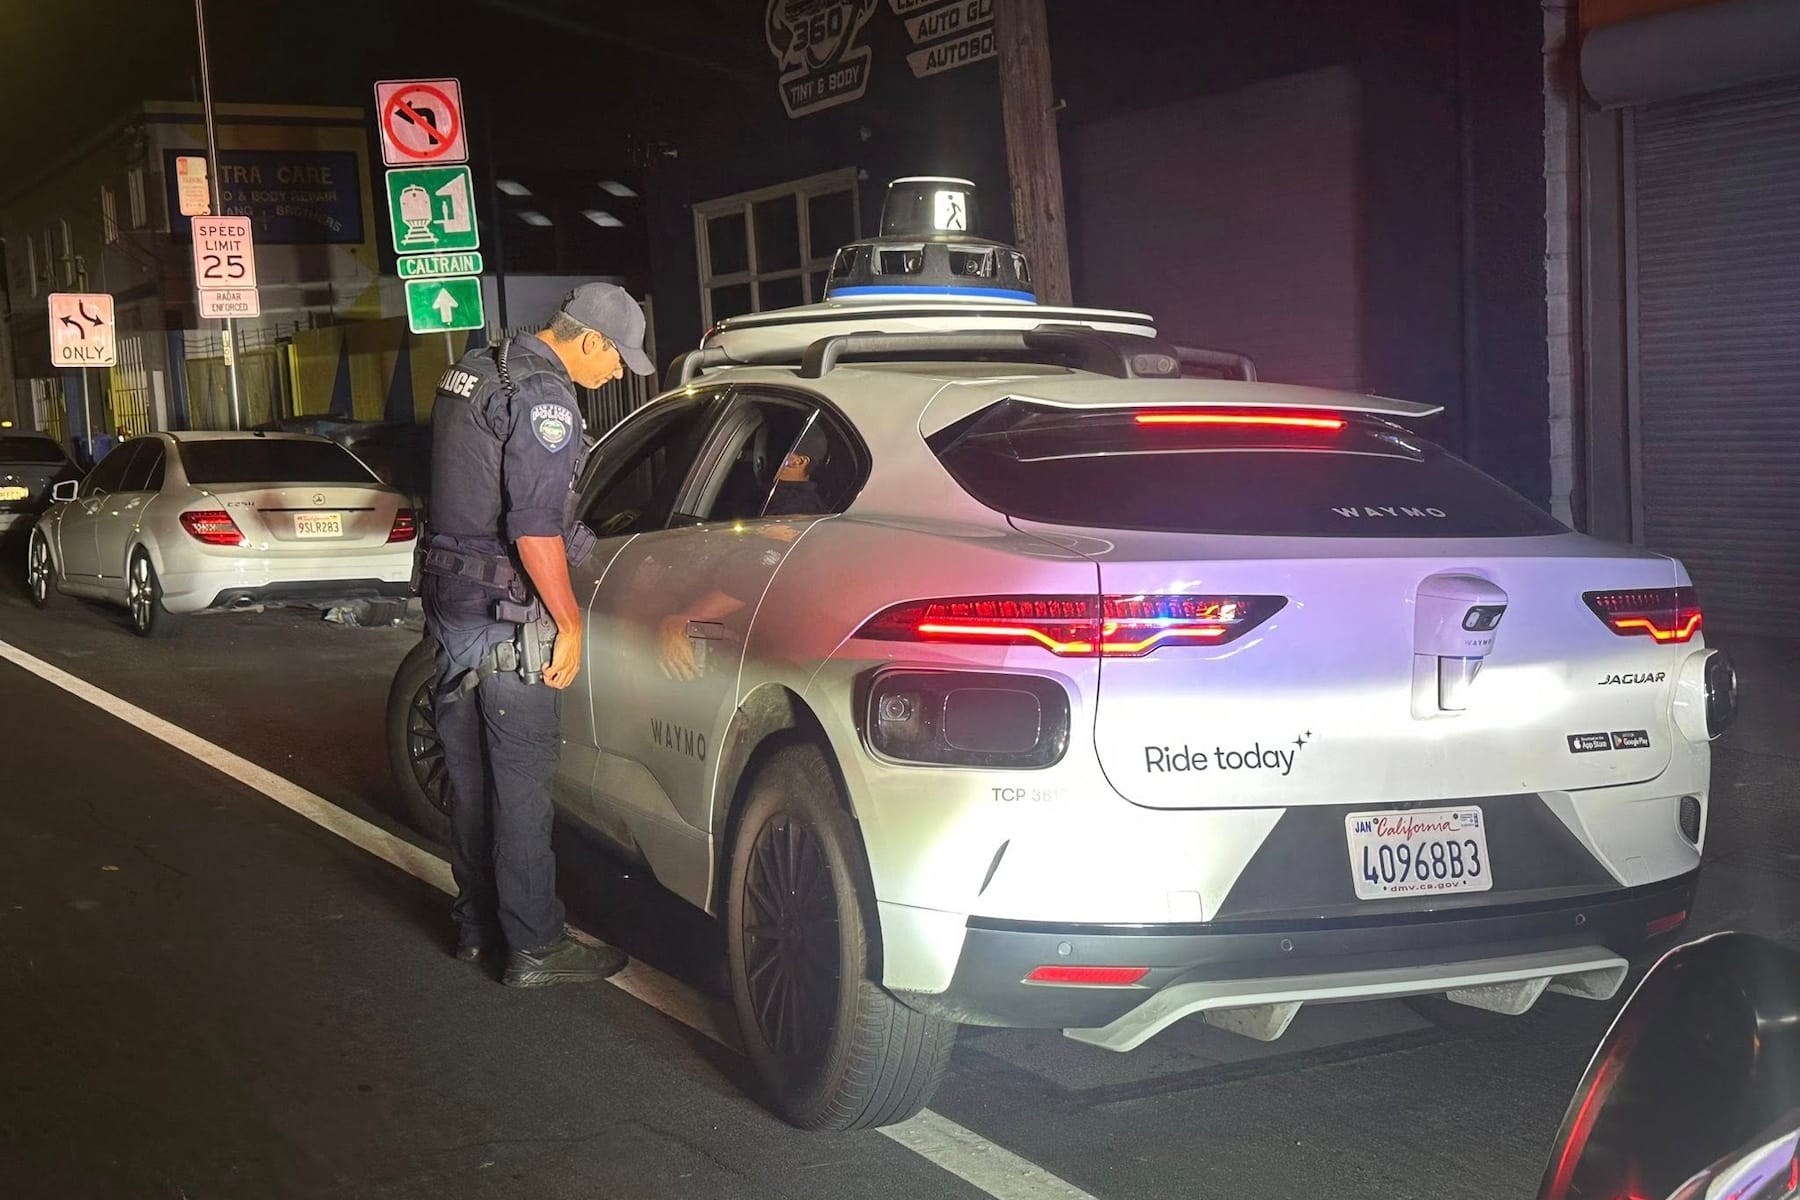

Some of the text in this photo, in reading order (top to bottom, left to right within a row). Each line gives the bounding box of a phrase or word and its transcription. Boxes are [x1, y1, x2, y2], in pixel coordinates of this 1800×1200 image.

[793, 6, 843, 52] 360
[917, 11, 959, 39] AUTO
[926, 34, 998, 71] AUTOBO
[790, 65, 860, 105] TINT & BODY
[221, 165, 334, 185] TRA CARE
[199, 226, 246, 237] SPEED
[205, 240, 241, 251] LIMIT
[203, 255, 245, 278] 25
[406, 255, 474, 275] CALTRAIN
[216, 292, 242, 301] RADAR
[211, 303, 248, 312] ENFORCED
[62, 346, 104, 361] ONLY
[440, 369, 479, 398] OLICE
[1331, 506, 1447, 518] WAYMO
[298, 521, 340, 534] 9SLR283
[1598, 672, 1666, 685] JAGUAR
[651, 718, 706, 761] WAYMO
[1145, 742, 1295, 776] Ride today
[992, 787, 1026, 801] TCP
[1355, 821, 1372, 833] JAN
[1377, 816, 1460, 841] California
[1363, 839, 1481, 884] 40968B3
[1390, 881, 1459, 893] dmv.ca.gov
